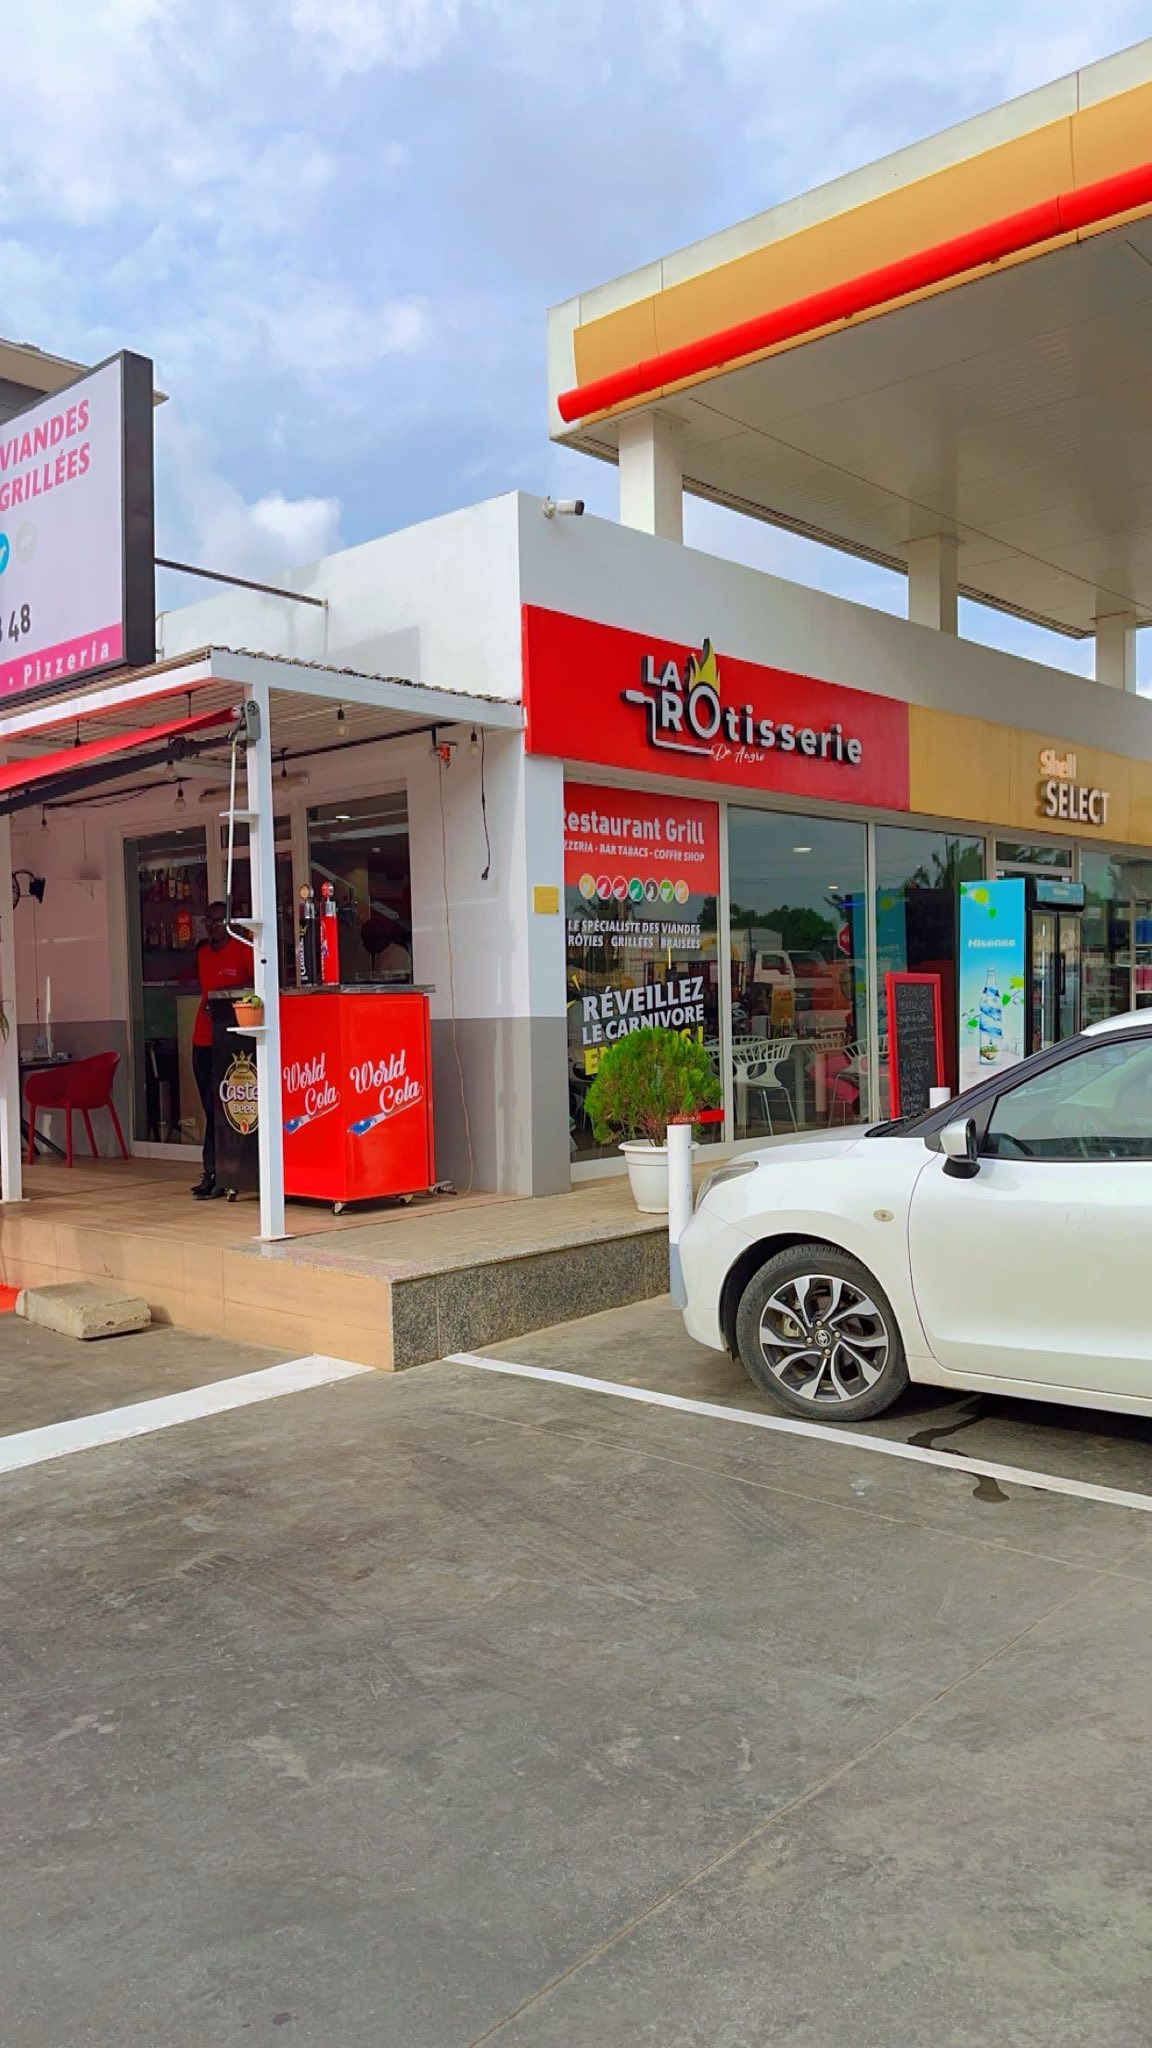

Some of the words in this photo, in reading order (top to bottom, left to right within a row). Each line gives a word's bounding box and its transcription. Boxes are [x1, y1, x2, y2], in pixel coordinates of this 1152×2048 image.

[0, 400, 89, 470] VIANDES
[0, 442, 90, 511] GRILLÉES
[8, 604, 30, 641] 48
[23, 641, 109, 685] Pizzeria
[642, 656, 682, 690] LA
[1040, 749, 1077, 779] Shell
[1044, 779, 1110, 824] SELECT
[665, 818, 705, 845] Grill
[600, 843, 617, 855] BAR
[618, 845, 649, 858] TABACS
[683, 852, 705, 862] SHOP
[568, 920, 580, 932] LE
[582, 918, 641, 934] SPÉCIALISTE
[642, 922, 660, 934] DES
[661, 923, 701, 935] VIANDES
[568, 933, 604, 947] RÔTIES
[968, 939, 1016, 948] Hisense
[582, 976, 704, 1023] RÉVEILLEZ
[583, 1023, 603, 1045] LE
[605, 1004, 704, 1040] CARNIVORE
[283, 1052, 326, 1094] World
[349, 1048, 407, 1094] World
[219, 1080, 258, 1103] Caste
[305, 1080, 339, 1116] Cola
[379, 1076, 423, 1113] Cola
